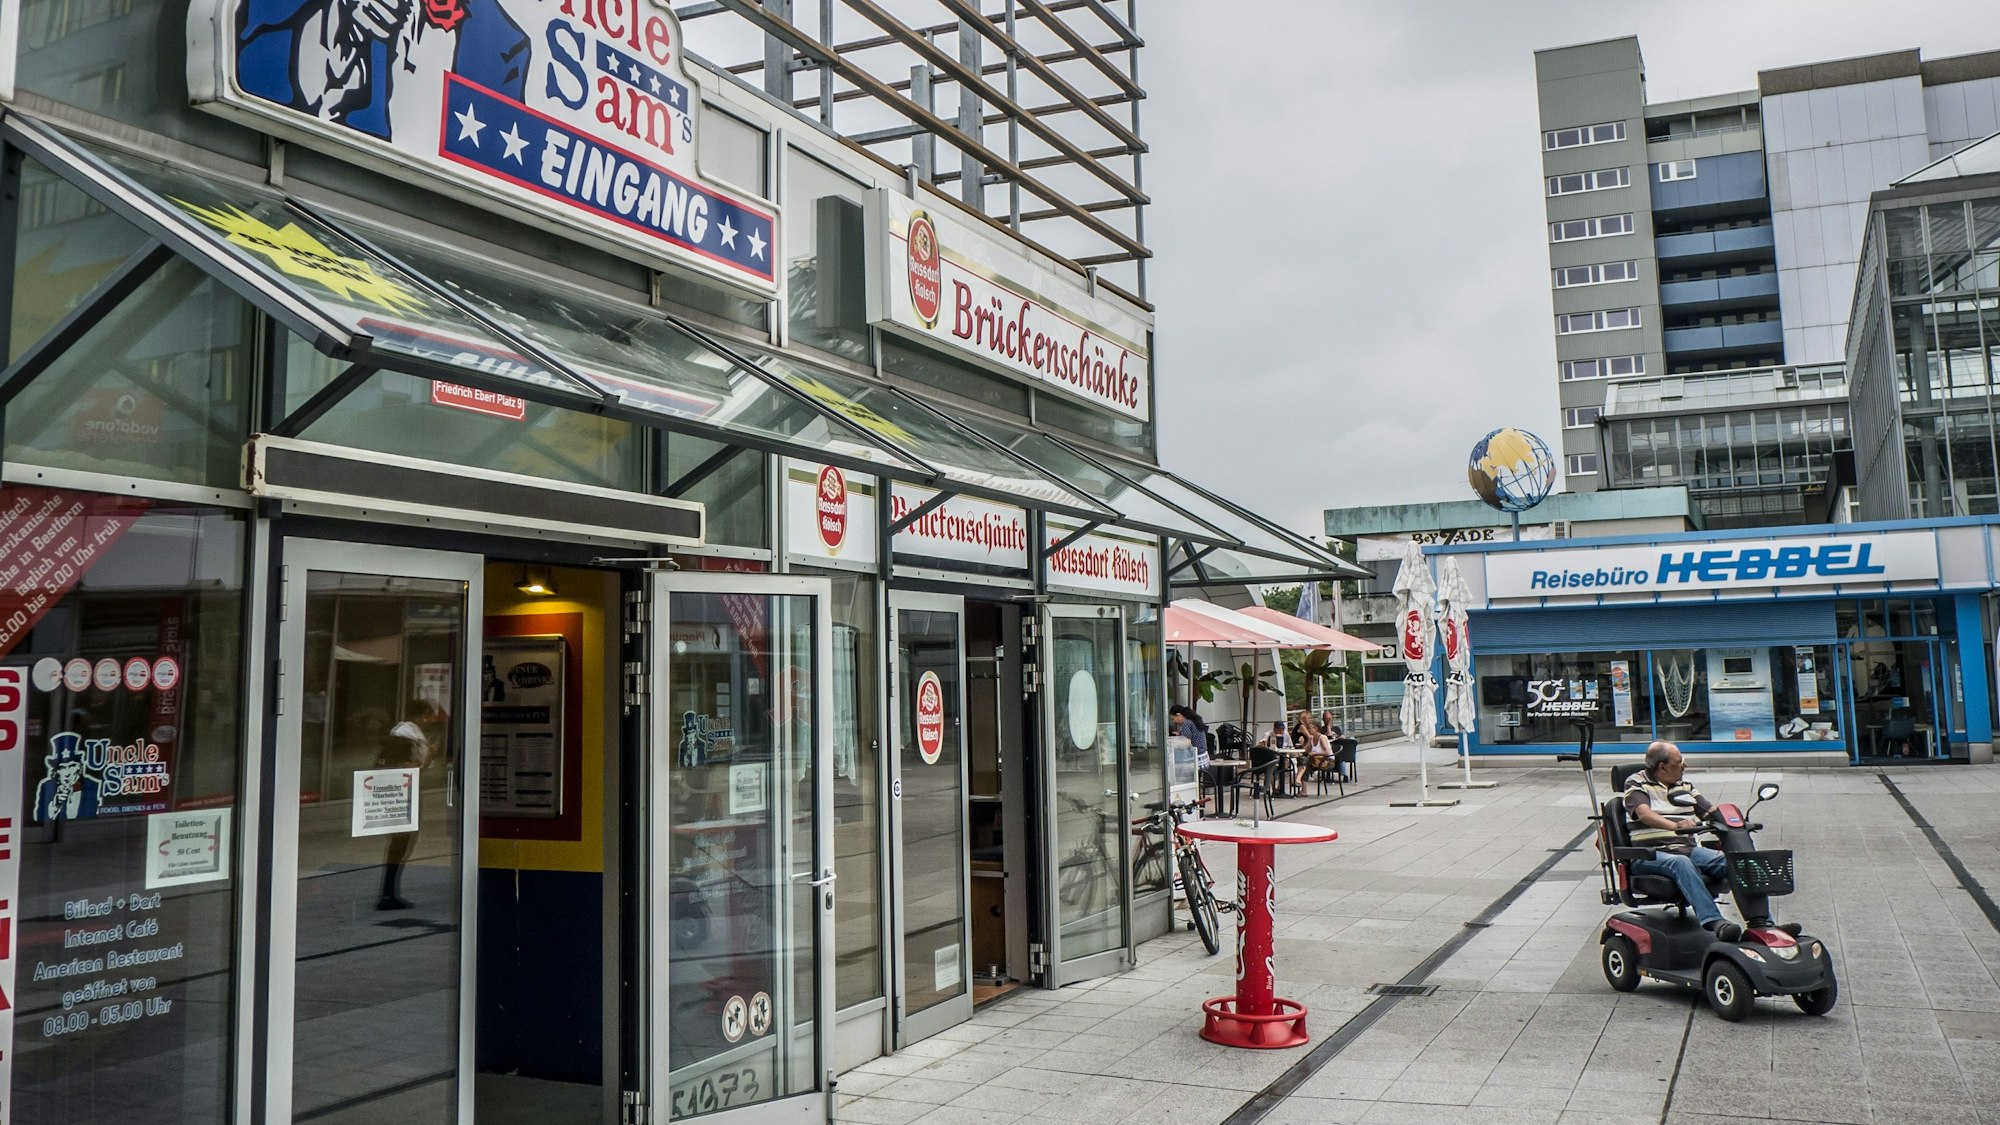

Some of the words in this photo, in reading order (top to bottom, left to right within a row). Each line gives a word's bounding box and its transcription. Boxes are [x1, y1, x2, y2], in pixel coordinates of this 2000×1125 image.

[540, 128, 709, 244] EINGANG
[909, 255, 940, 283] Reissdorf
[914, 279, 936, 305] Kölsch
[951, 278, 1138, 409] Brückenschänke
[435, 380, 473, 398] Friedrich
[474, 388, 496, 404] Ebert
[497, 394, 516, 408] Platz
[516, 398, 522, 409] 9
[0, 496, 32, 532] nfach
[818, 497, 846, 515] Reissdorf
[0, 494, 62, 561] erikanische
[17, 550, 35, 566] in
[31, 501, 85, 552] Bestform
[822, 515, 842, 534] Kölsch
[15, 557, 56, 596] täglich
[54, 536, 78, 558] von
[1111, 545, 1149, 589] Kölsch
[1531, 569, 1649, 589] Reisebüro
[1656, 543, 1885, 584] HEBBEL
[0, 610, 28, 648] 6.00
[24, 593, 47, 614] bis
[44, 563, 74, 594] 5.00
[71, 542, 96, 567] Uhr
[94, 518, 121, 545] früh
[1541, 701, 1599, 711] HEBBEL
[85, 738, 160, 771] Uncle
[121, 804, 146, 813] DRINKS
[152, 803, 166, 811] FUN
[171, 831, 208, 841] Benutzung
[185, 847, 201, 855] Cent
[64, 896, 113, 920] Billard
[129, 892, 161, 911] Dart
[64, 924, 123, 948] Internet
[125, 918, 159, 938] Café
[33, 957, 104, 981] American
[106, 942, 184, 970] Restaurant
[62, 977, 128, 1010] geöffnet
[130, 976, 157, 991] von
[43, 1010, 89, 1037] 08.00
[100, 1000, 143, 1026] 05.00
[145, 996, 173, 1016] Uhr
